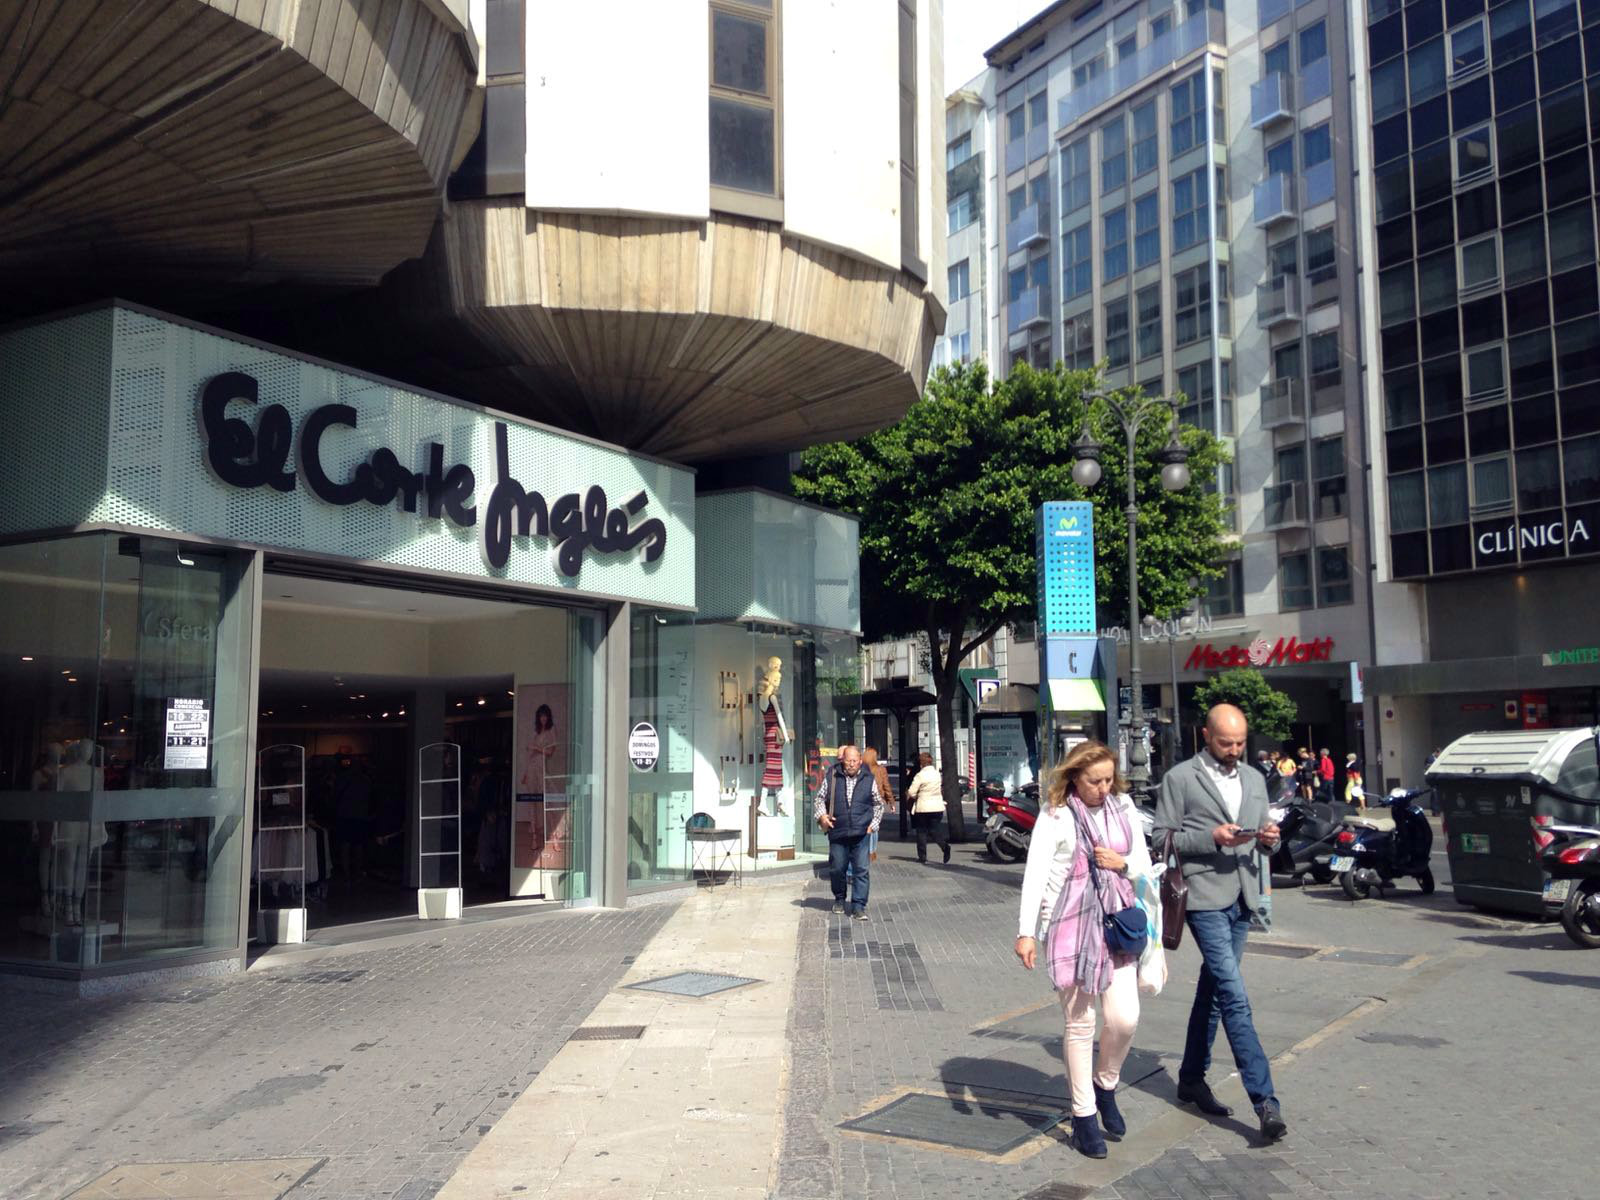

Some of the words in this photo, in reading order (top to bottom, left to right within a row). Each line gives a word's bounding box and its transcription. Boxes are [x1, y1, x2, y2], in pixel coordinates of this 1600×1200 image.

[200, 371, 297, 493] El
[299, 403, 476, 527] Corte
[479, 422, 667, 578] Inglés
[1478, 518, 1590, 555] CLÍNICA
[1101, 624, 1150, 643] HOTL
[1185, 644, 1250, 671] Media
[1267, 636, 1334, 665] Markt
